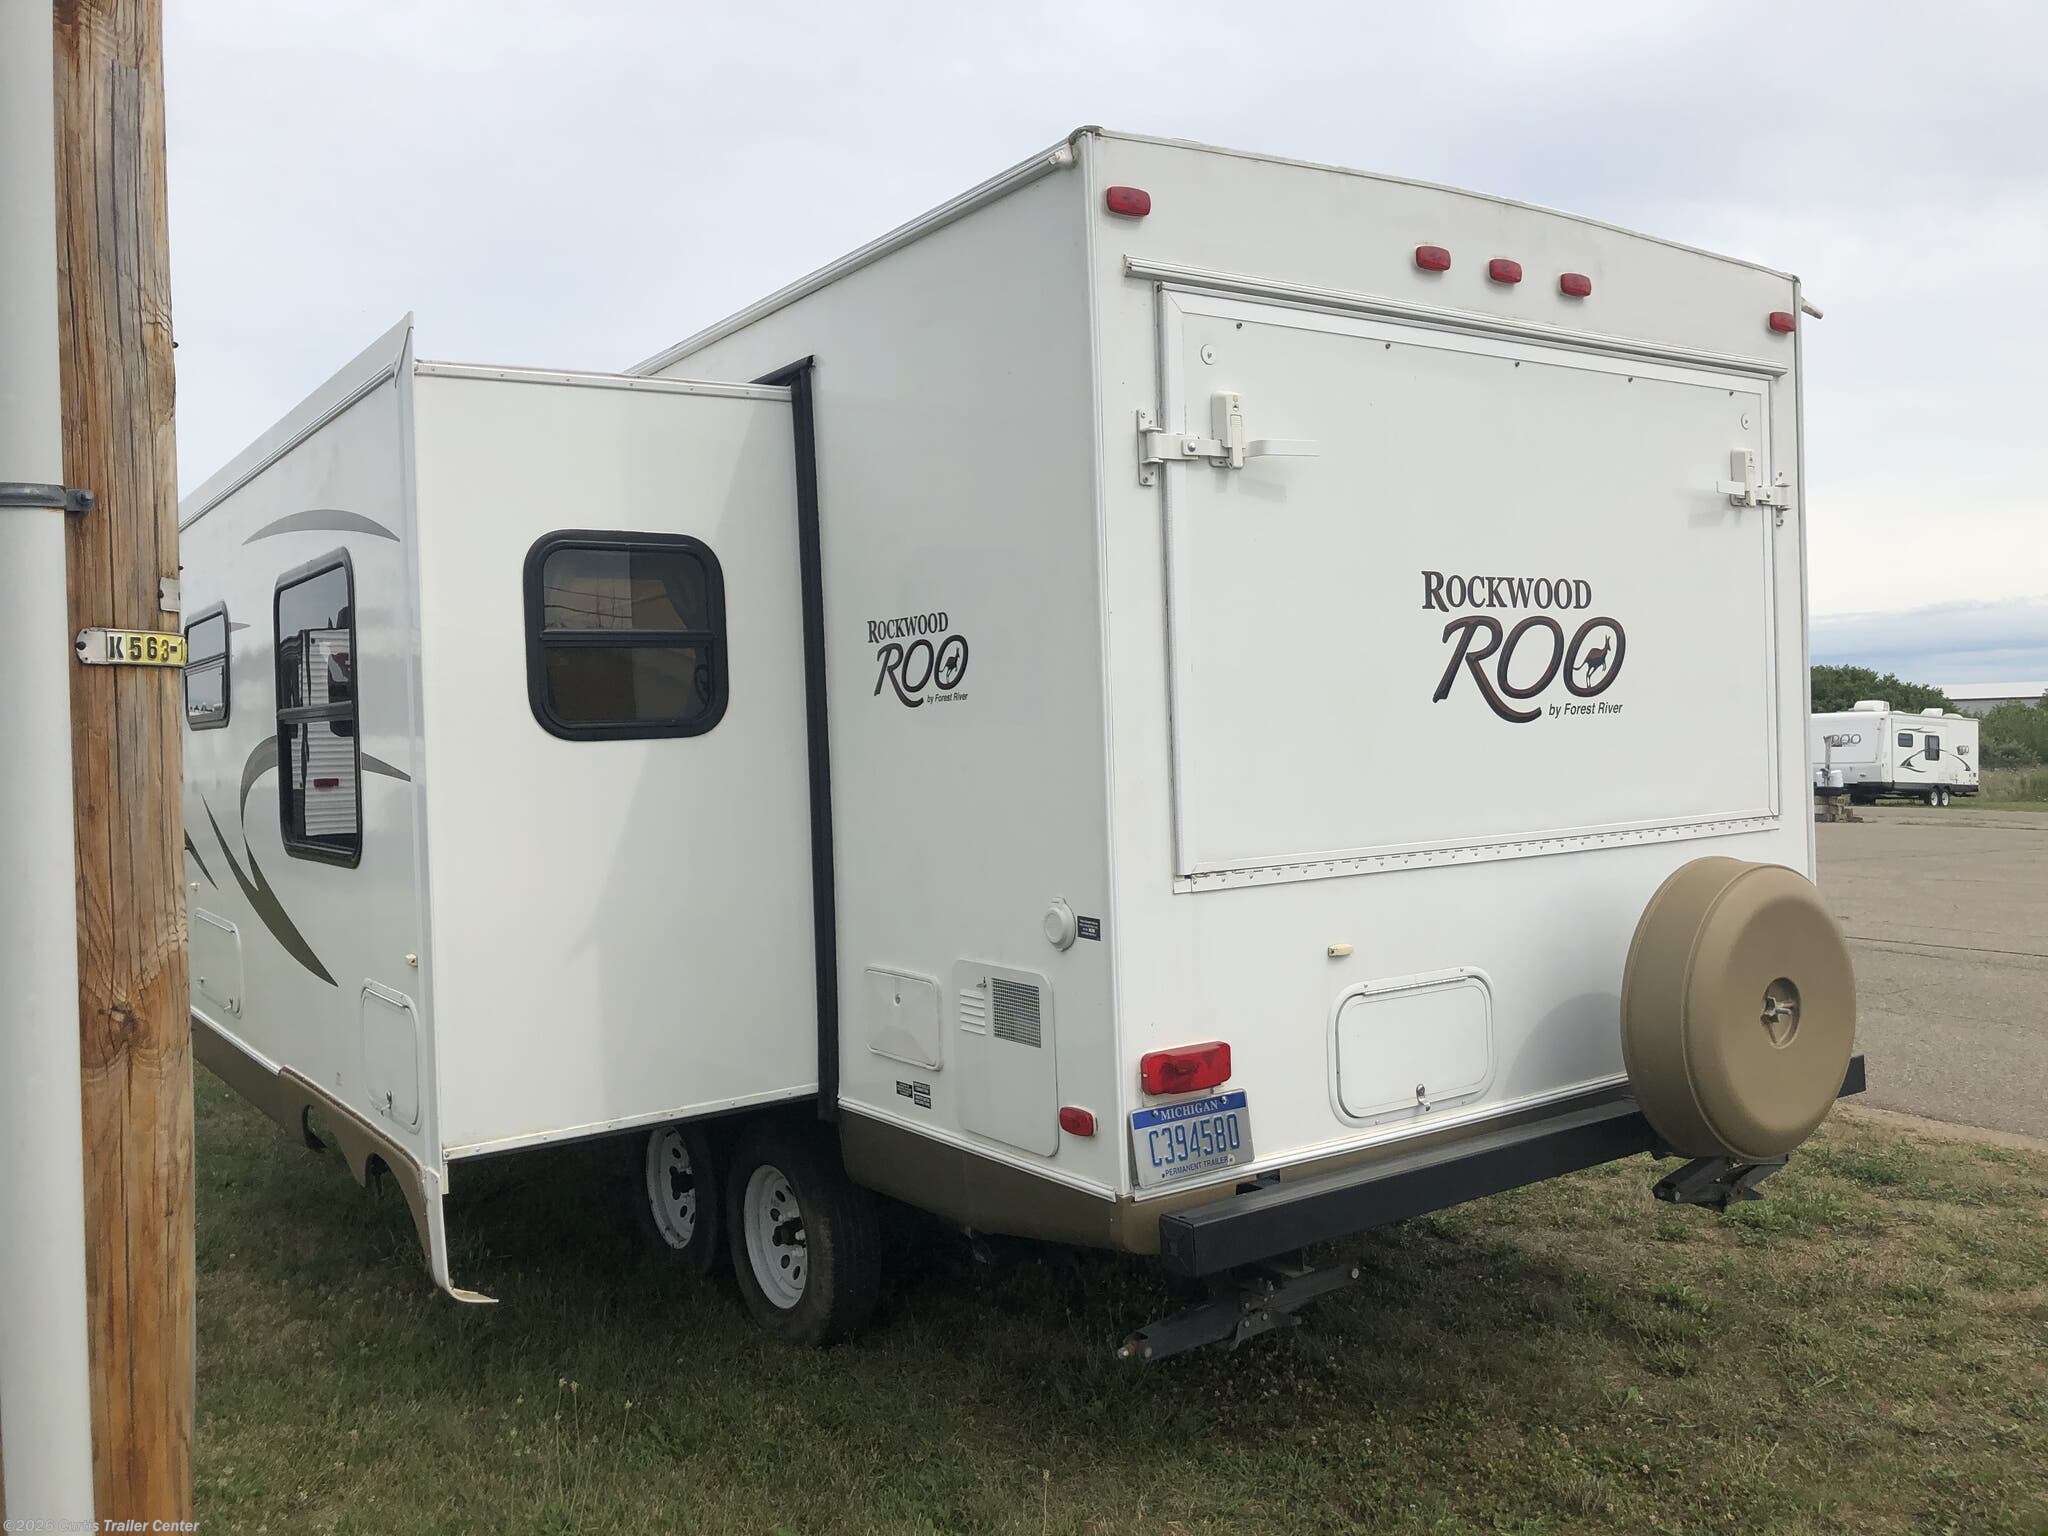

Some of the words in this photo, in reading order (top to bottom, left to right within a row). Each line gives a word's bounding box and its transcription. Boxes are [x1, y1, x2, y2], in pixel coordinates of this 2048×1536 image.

[1421, 570, 1592, 612] ROCKWOOD
[867, 612, 949, 644] ROCKWOOD
[109, 636, 124, 659] K
[874, 634, 969, 708] ROO
[1432, 615, 1626, 723] ROO
[927, 694, 934, 704] by
[935, 693, 952, 702] Forest
[953, 692, 968, 701] River
[1549, 704, 1561, 719] by
[1563, 702, 1595, 715] Forest
[1597, 702, 1623, 714] River
[1160, 1099, 1218, 1120] MICHIGAN
[1149, 1112, 1240, 1167] C394580
[1165, 1161, 1202, 1177] PERMANENT
[1204, 1155, 1229, 1168] TRAILER
